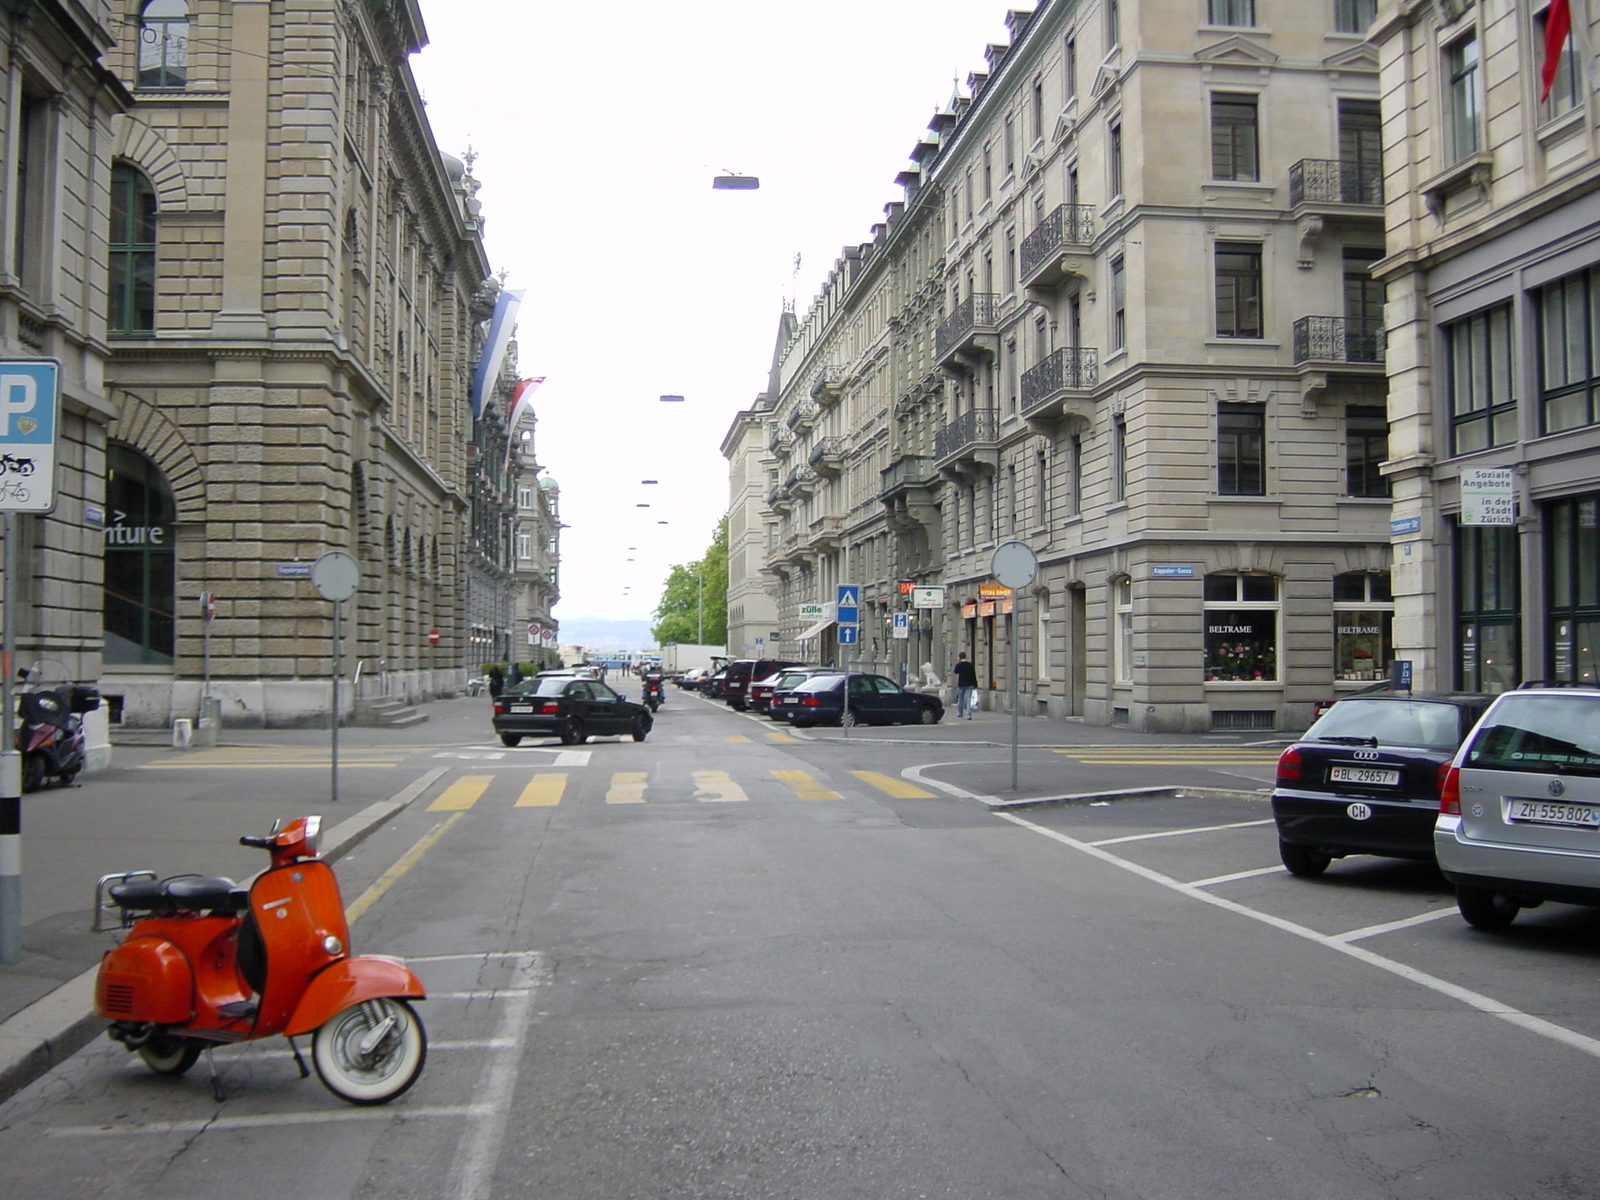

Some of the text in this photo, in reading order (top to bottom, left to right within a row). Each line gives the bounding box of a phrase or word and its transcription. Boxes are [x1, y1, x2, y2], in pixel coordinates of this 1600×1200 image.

[1, 374, 36, 436] P
[1463, 480, 1510, 489] Angebote
[801, 605, 822, 613] zülle
[1209, 625, 1252, 634] BELTRAME
[1337, 626, 1380, 635] BELTRAME
[1352, 805, 1366, 818] CH
